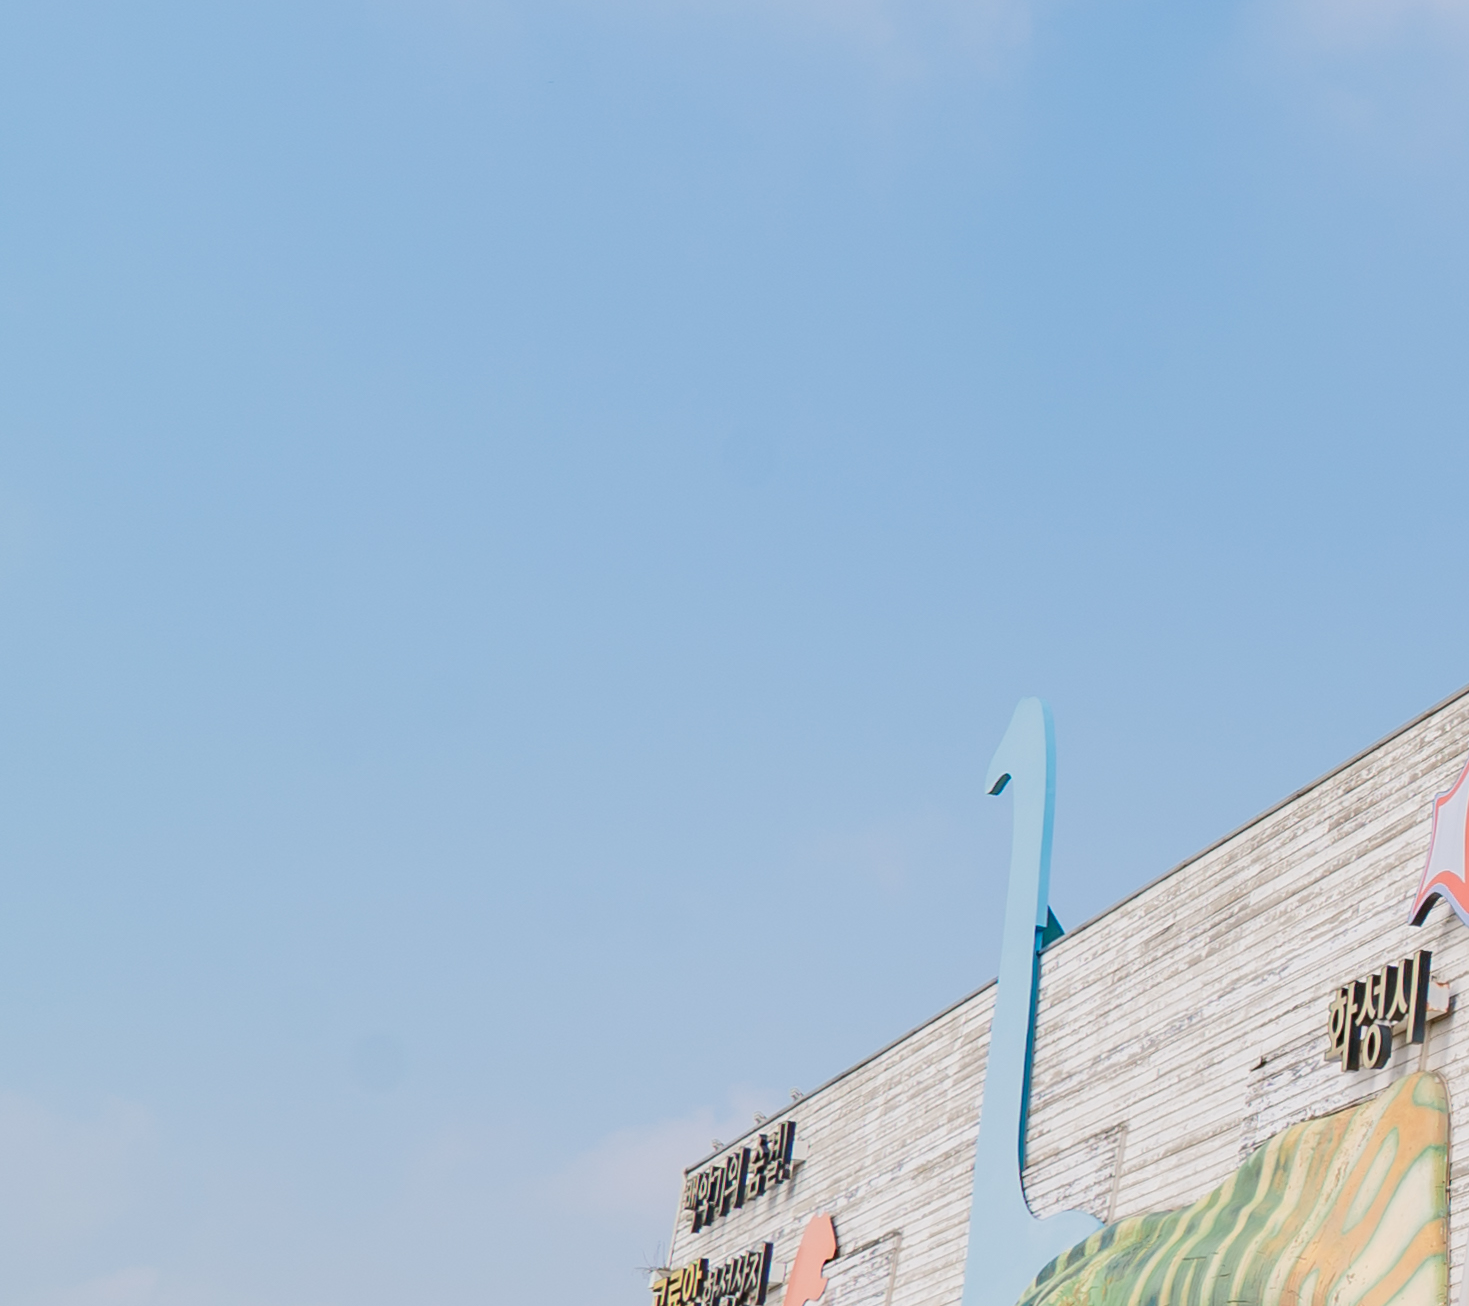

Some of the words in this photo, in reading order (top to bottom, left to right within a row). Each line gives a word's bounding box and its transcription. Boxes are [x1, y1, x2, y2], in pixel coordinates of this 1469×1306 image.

[1324, 950, 1432, 1072] 화성시
[684, 1147, 750, 1233] 백악기의
[748, 1121, 796, 1201] 숨결
